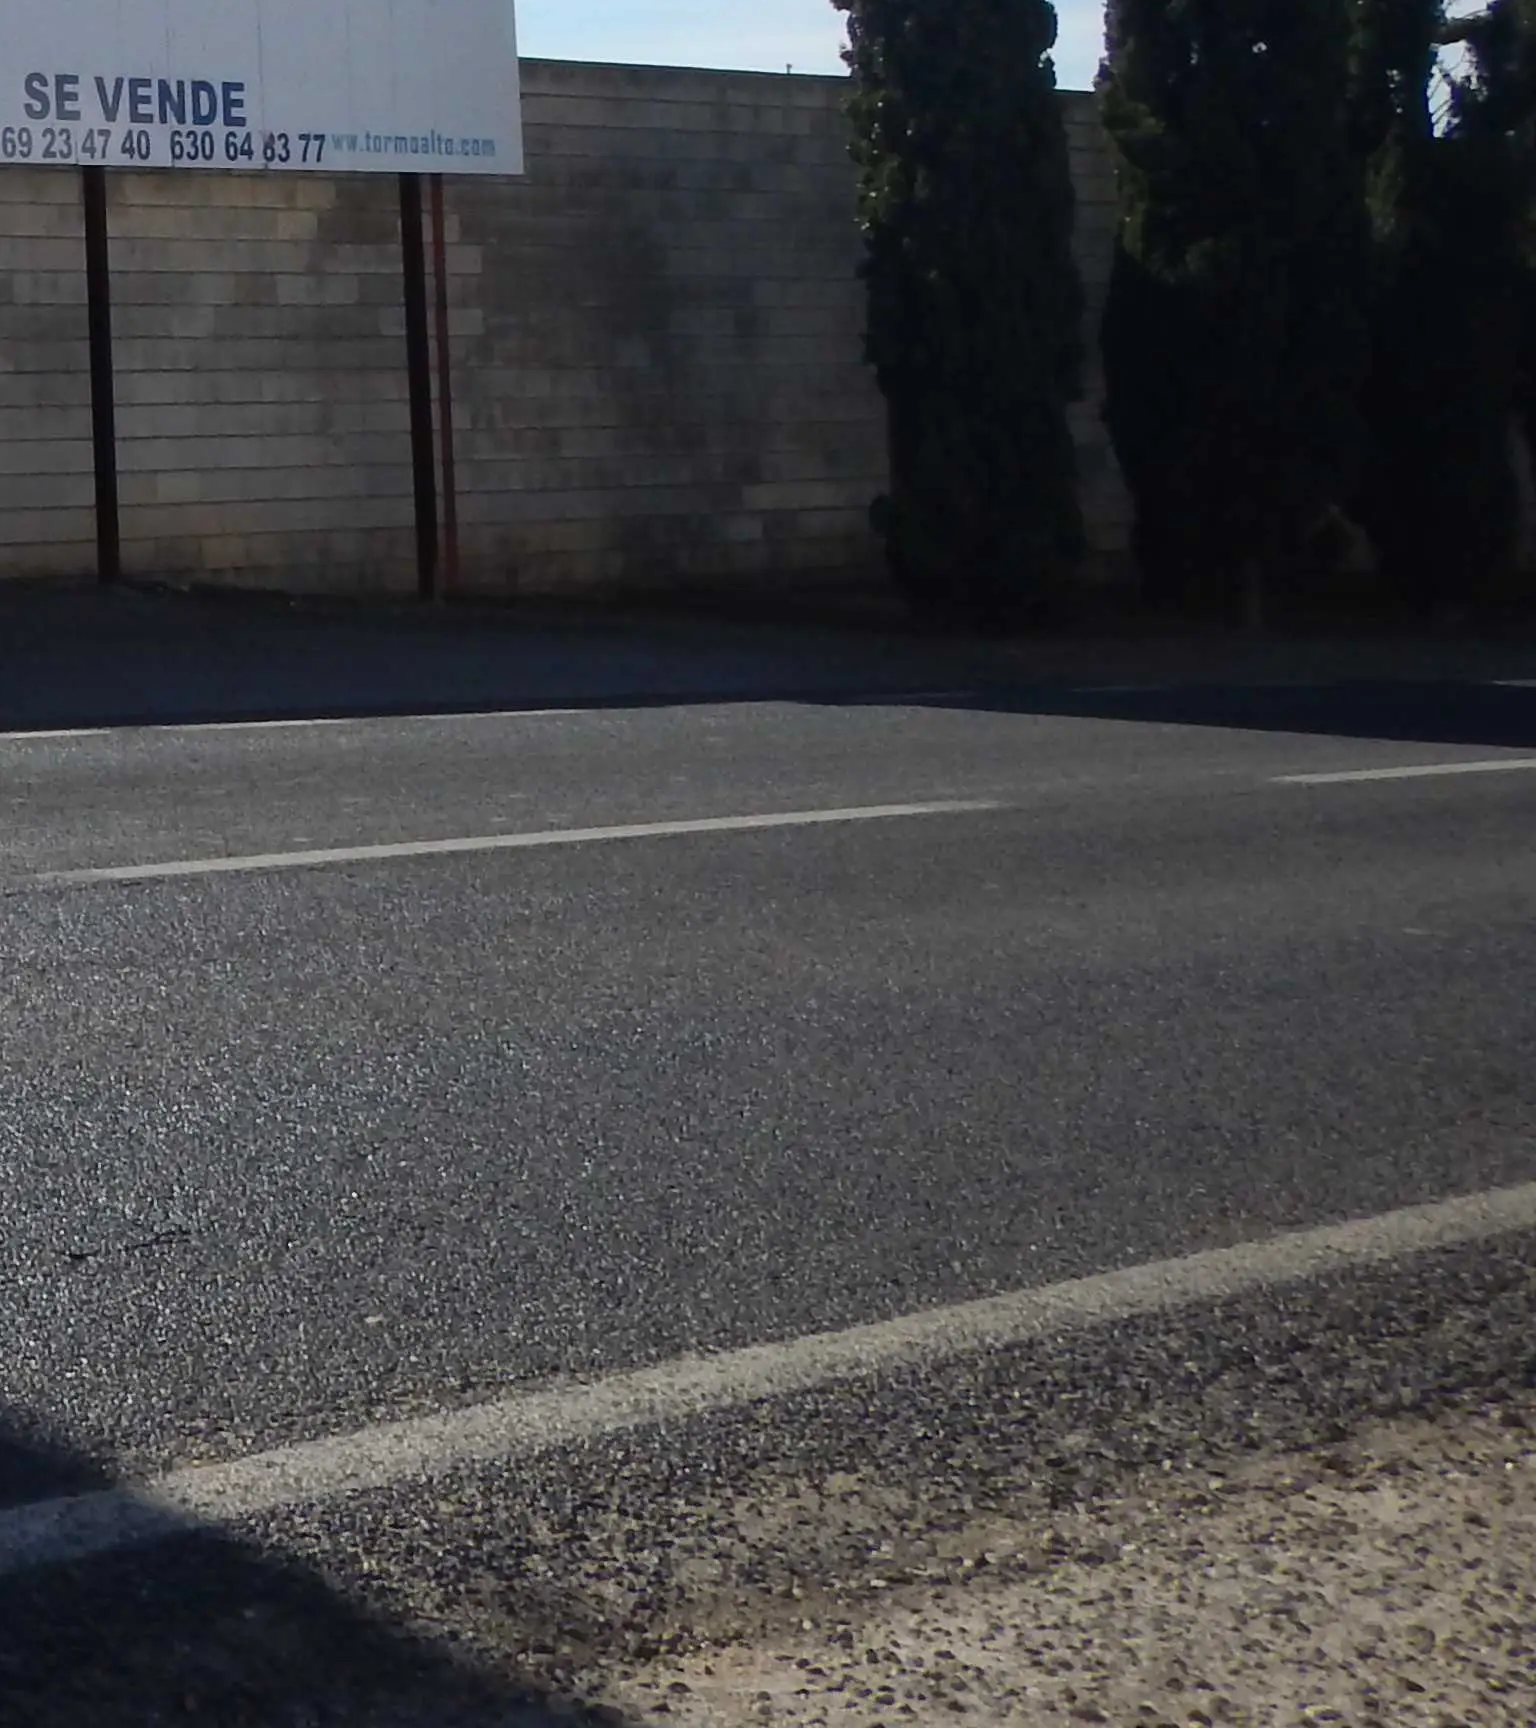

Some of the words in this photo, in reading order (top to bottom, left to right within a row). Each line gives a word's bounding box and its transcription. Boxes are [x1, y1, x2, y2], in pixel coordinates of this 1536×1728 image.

[24, 73, 81, 120] SE
[94, 77, 245, 126] VENDE
[42, 128, 72, 160] 23
[82, 129, 111, 159] 47
[121, 130, 150, 160] 40
[171, 130, 214, 161] 630
[225, 131, 253, 162] 64
[298, 133, 326, 163] 77
